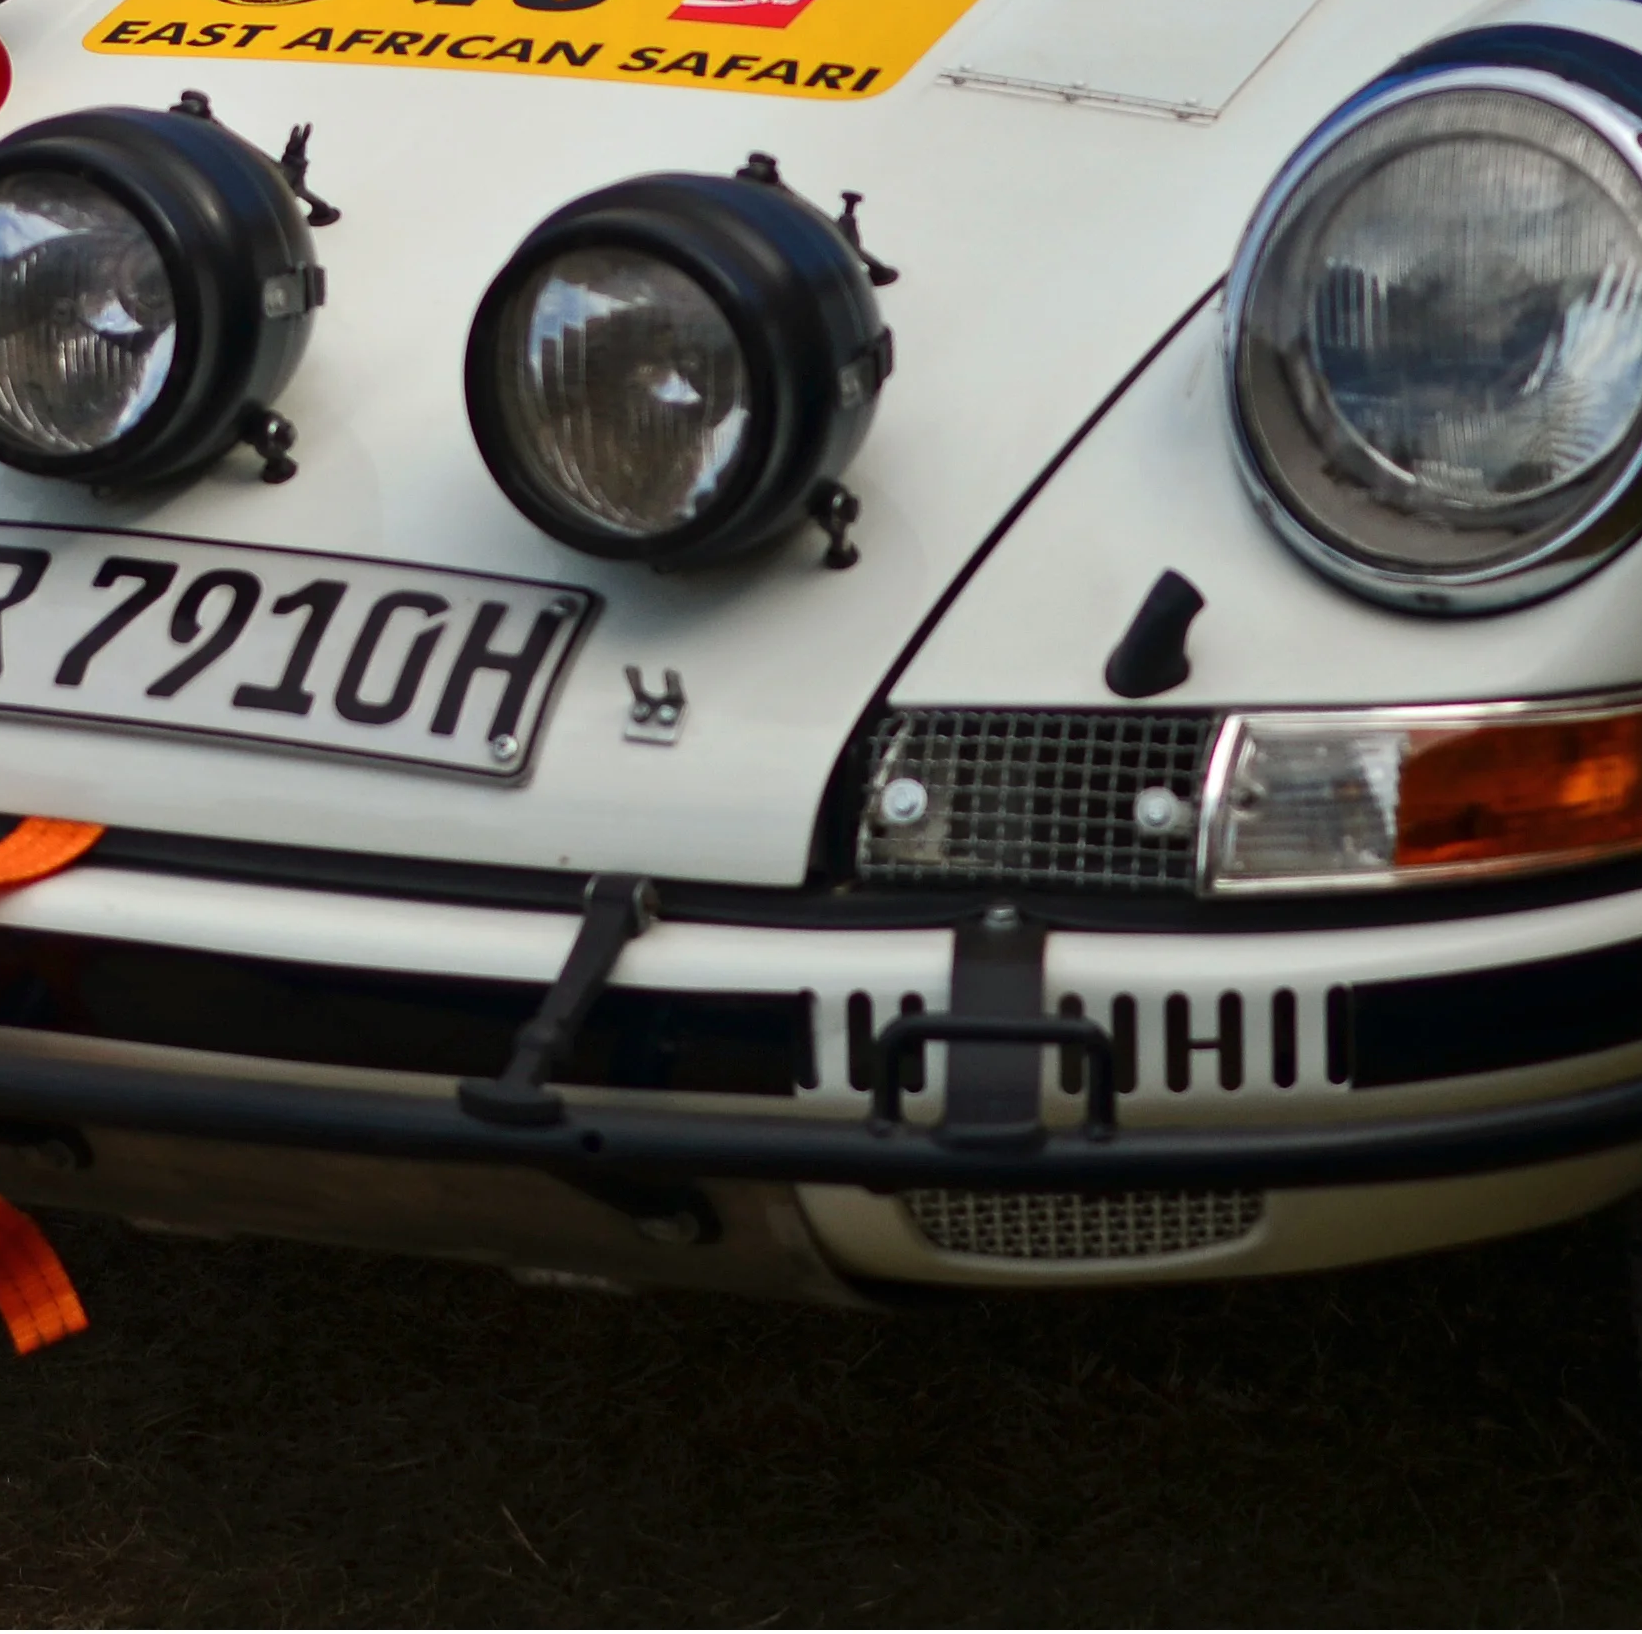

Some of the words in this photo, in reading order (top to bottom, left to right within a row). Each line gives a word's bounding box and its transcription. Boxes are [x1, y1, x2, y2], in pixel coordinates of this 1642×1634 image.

[100, 19, 281, 52] EAST
[281, 25, 604, 68] AFRICAN
[617, 44, 884, 96] SAFARI
[54, 556, 566, 745] 7910H
